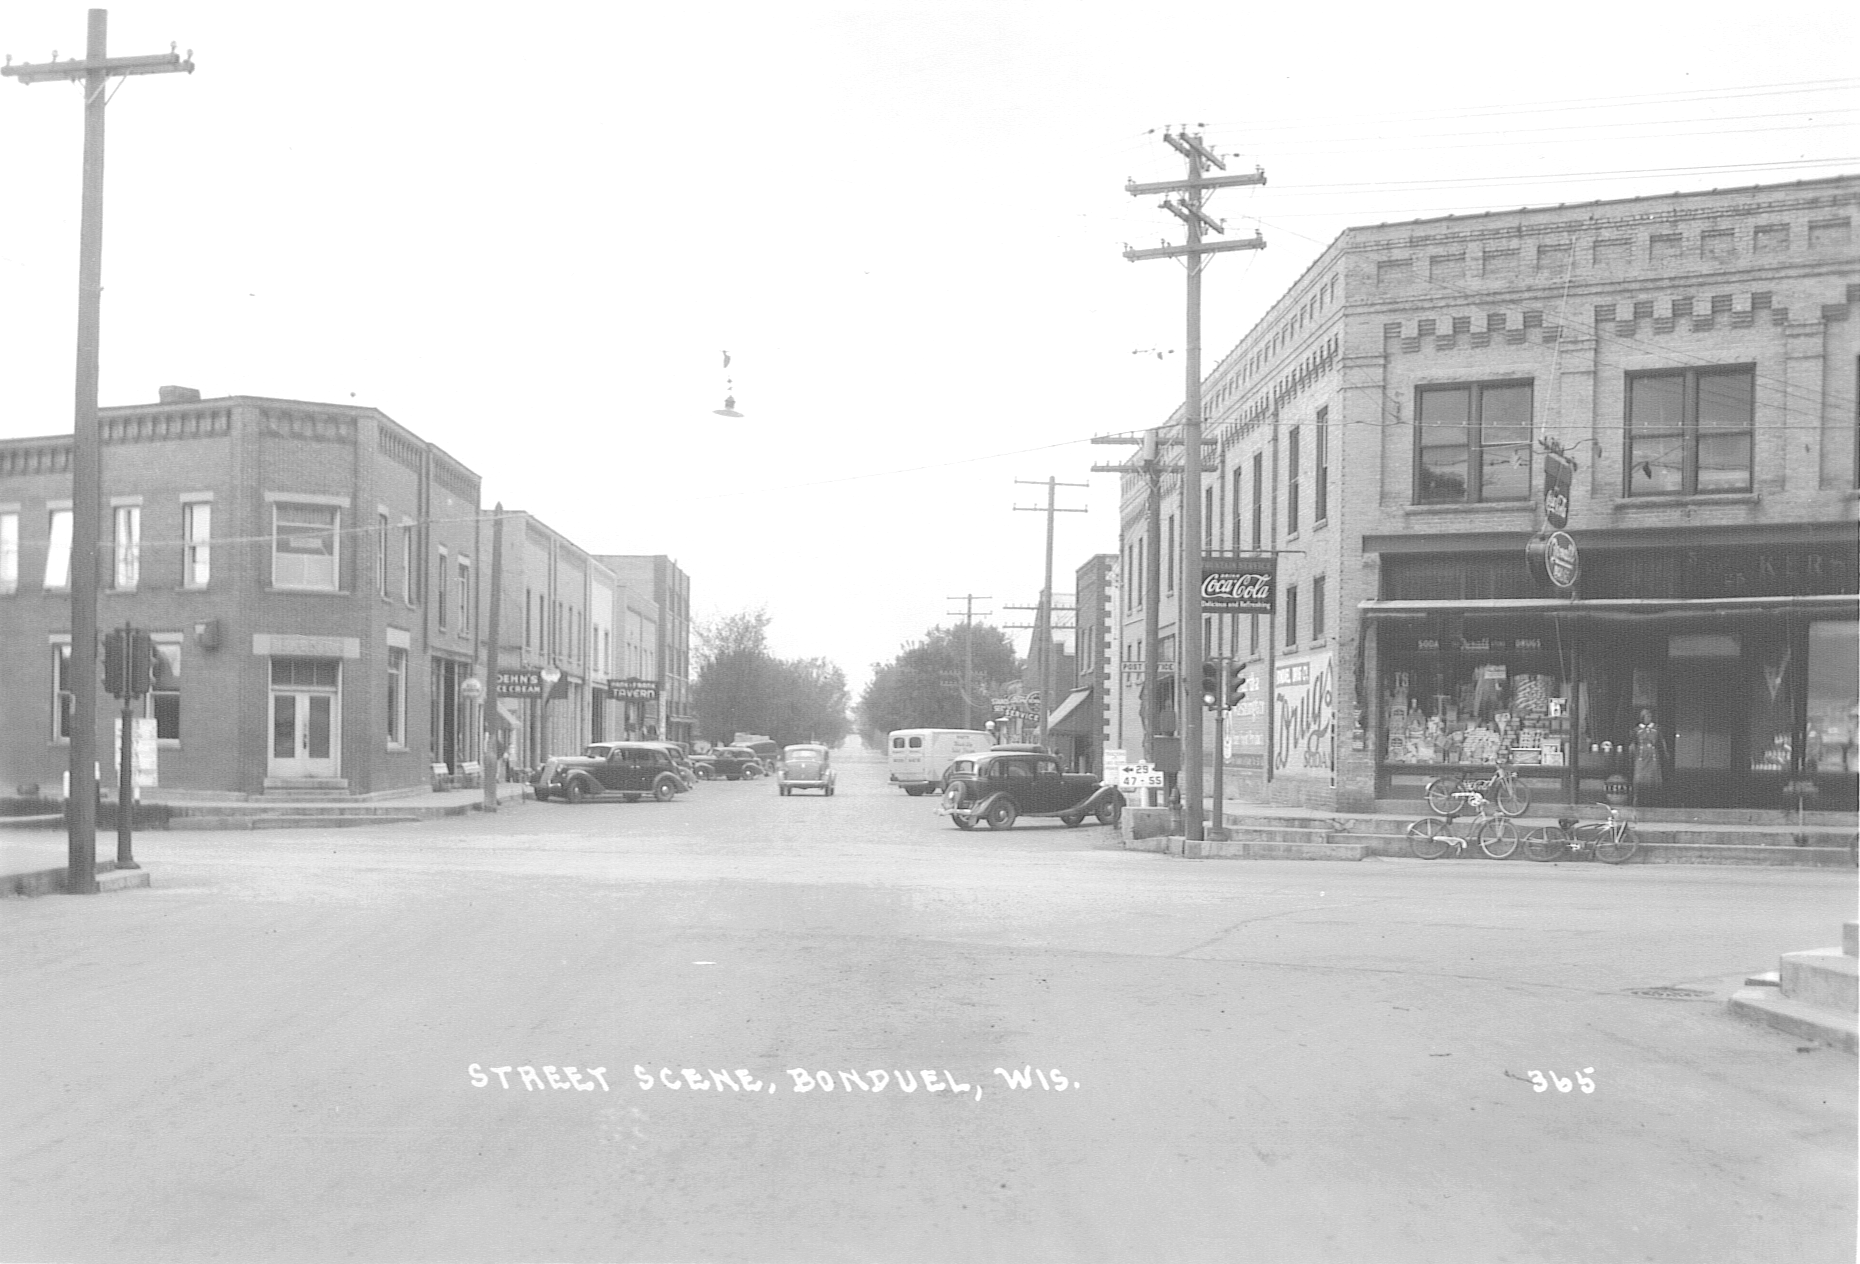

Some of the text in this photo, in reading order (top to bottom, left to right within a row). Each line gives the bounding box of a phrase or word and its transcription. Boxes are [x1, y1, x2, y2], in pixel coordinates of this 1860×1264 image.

[1201, 600, 1271, 610] Delicious and Refreshing
[1123, 663, 1142, 671] POST
[508, 685, 541, 693] CREAM
[613, 688, 656, 698] TAVERN
[1005, 709, 1039, 721] SERVICE
[1136, 765, 1149, 774] 29
[1123, 777, 1137, 785] 47
[1148, 776, 1162, 785] 55
